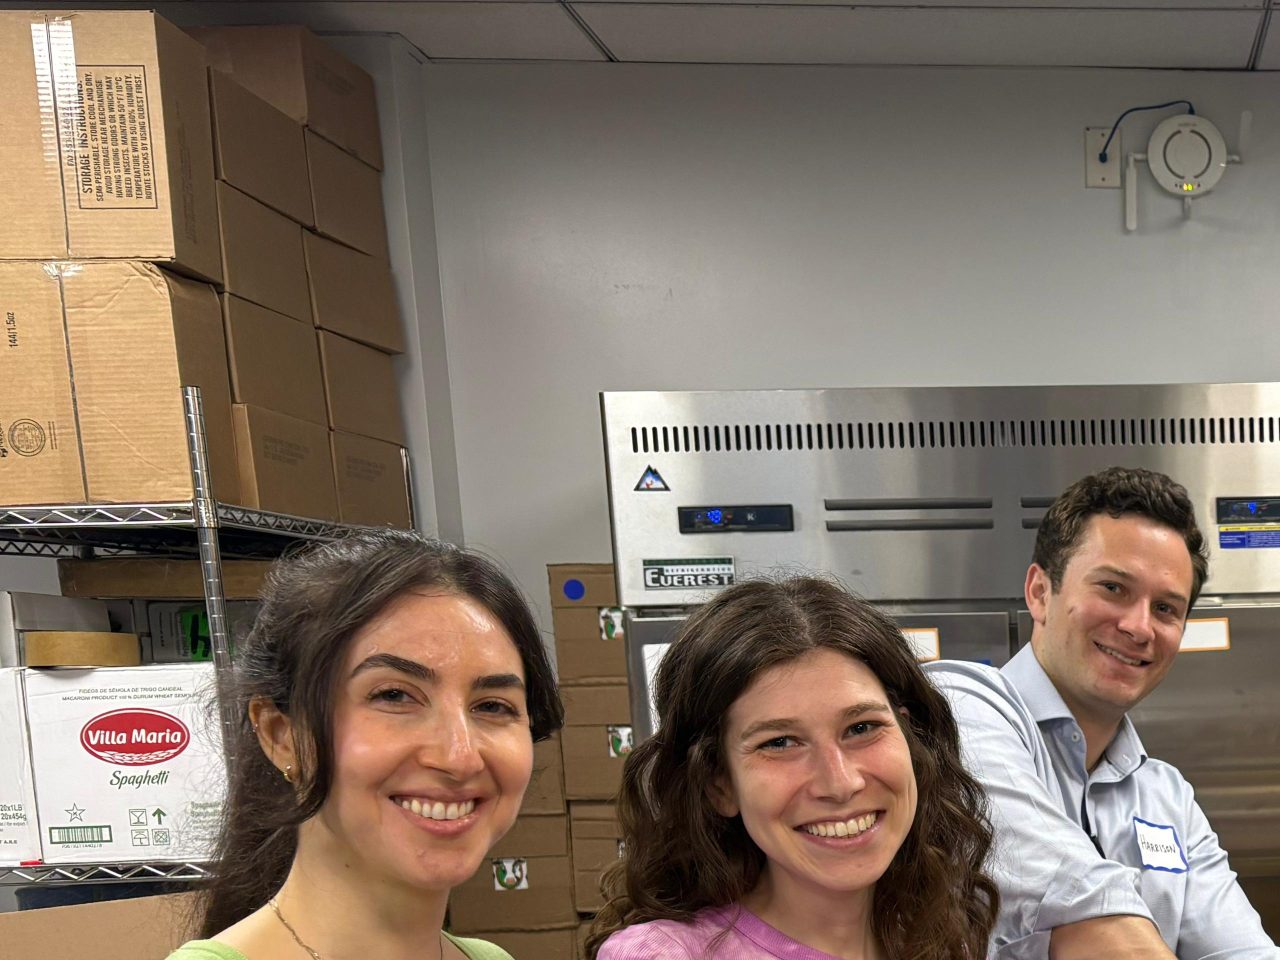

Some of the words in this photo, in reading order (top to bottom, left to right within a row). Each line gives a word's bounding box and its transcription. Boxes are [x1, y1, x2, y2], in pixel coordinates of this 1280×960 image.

[84, 71, 93, 85] DRY.
[105, 76, 113, 89] MAY
[134, 74, 143, 95] FIRST.
[86, 90, 94, 102] AND
[125, 74, 134, 107] HUMIDITY.
[95, 79, 106, 126] MERCHANDISE
[137, 96, 145, 119] OLDEST
[108, 114, 116, 123] OR
[109, 124, 117, 145] ODORS
[119, 114, 127, 145] MAINTAIN
[139, 120, 147, 140] USING
[130, 135, 138, 152] WITH
[141, 142, 148, 152] BY
[102, 147, 111, 174] STORAGE
[112, 146, 120, 171] STRONG
[122, 149, 131, 175] INSECTS.
[141, 152, 150, 176] STOCKS
[80, 153, 92, 194] STORAGE
[132, 154, 143, 200] TEMPERATURE
[104, 175, 113, 194] AVOID
[113, 174, 123, 198] HAVING
[124, 177, 133, 198] BREED
[143, 178, 153, 200] ROTATE
[87, 730, 127, 746] Villa
[132, 728, 182, 744] Maria
[109, 770, 170, 789] Spaghetti
[1139, 833, 1176, 854] HARRISON
